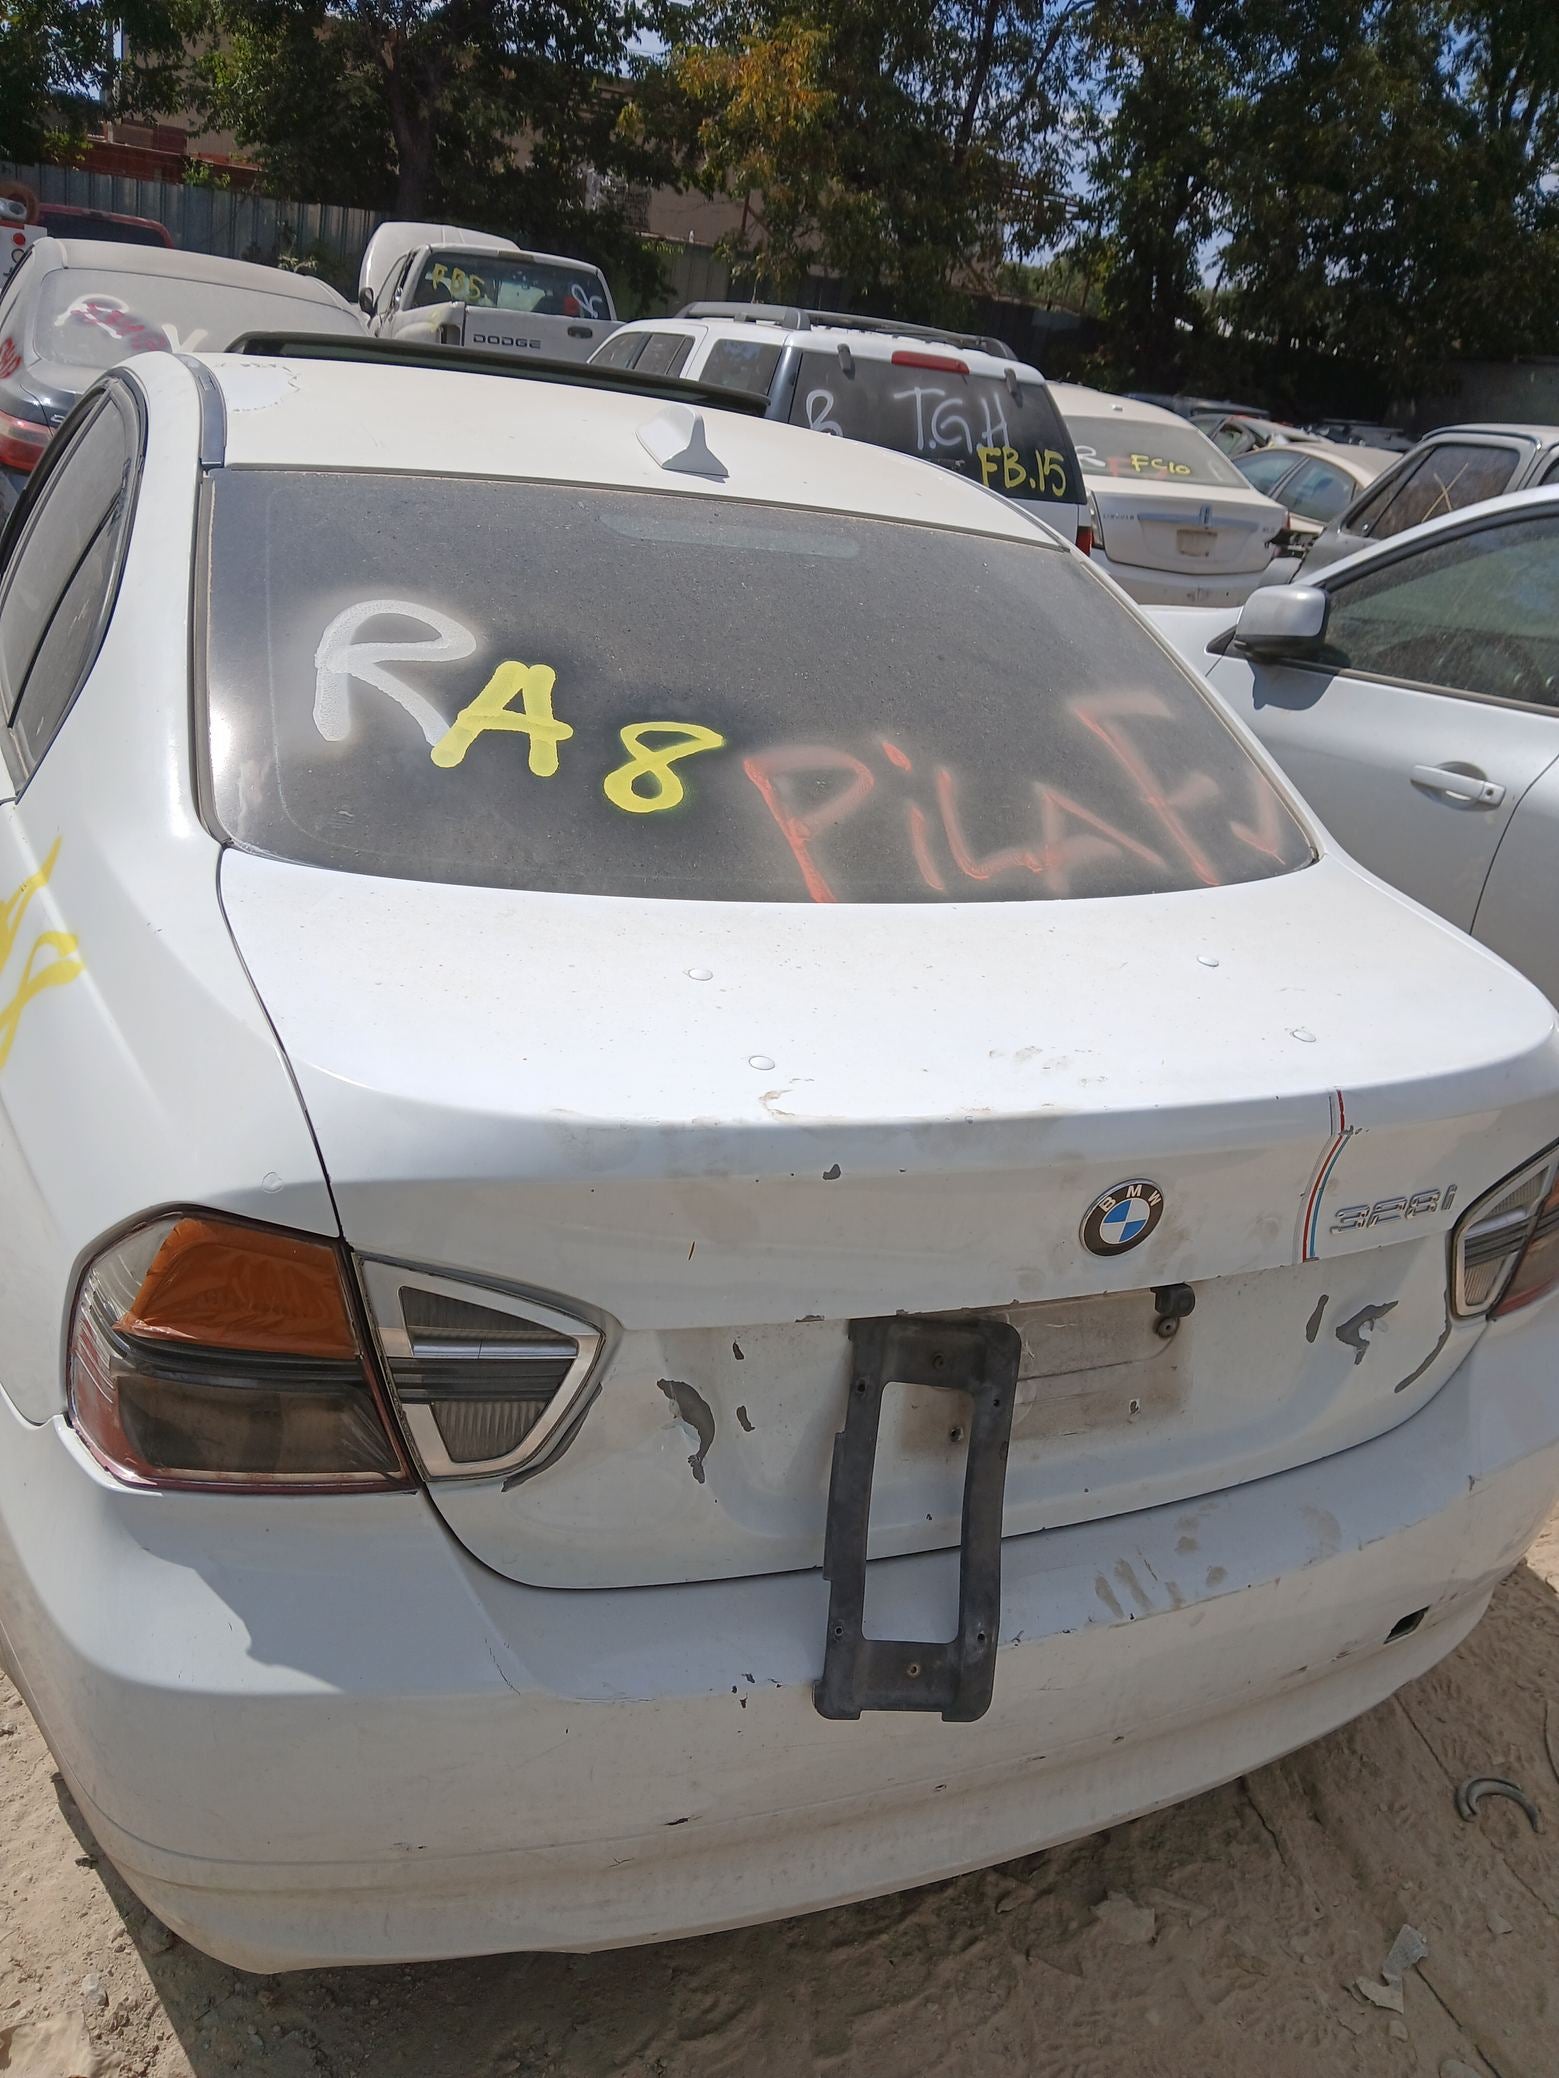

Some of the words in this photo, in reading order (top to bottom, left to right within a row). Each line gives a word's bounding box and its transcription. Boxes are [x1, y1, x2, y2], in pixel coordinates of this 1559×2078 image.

[473, 334, 541, 349] DODGE
[1099, 1184, 1162, 1213] BMW
[1329, 1183, 1458, 1235] 328i
